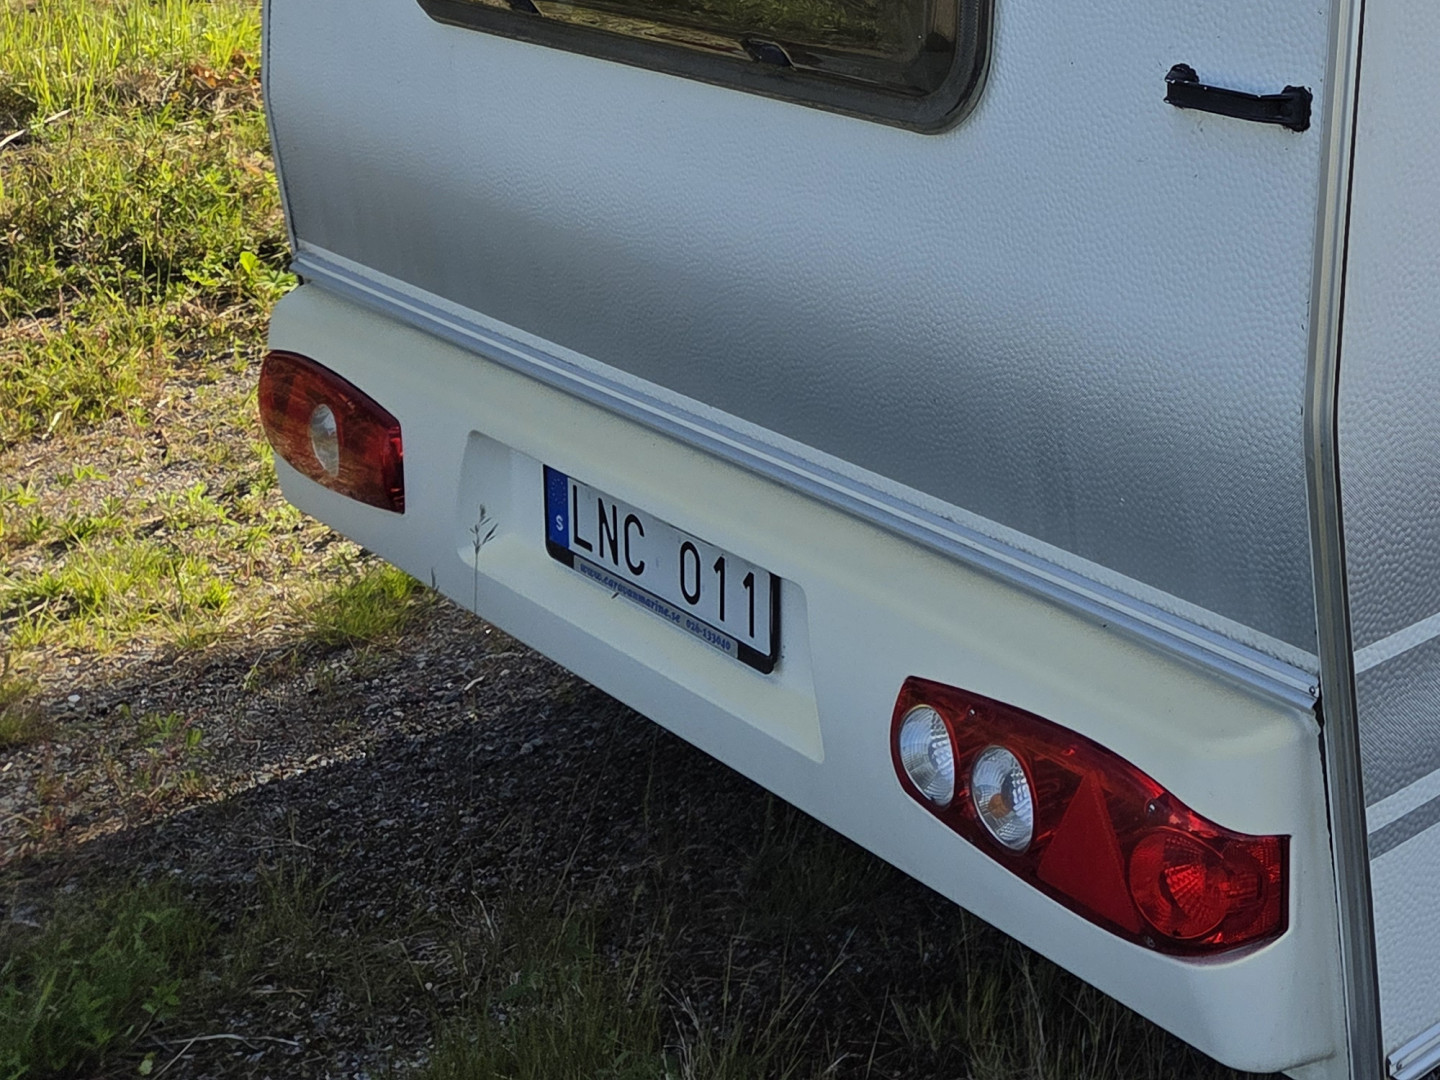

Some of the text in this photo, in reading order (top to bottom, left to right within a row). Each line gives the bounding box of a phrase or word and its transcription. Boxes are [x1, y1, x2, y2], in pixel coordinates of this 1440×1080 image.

[556, 515, 564, 531] S
[573, 485, 755, 638] LNC 011
